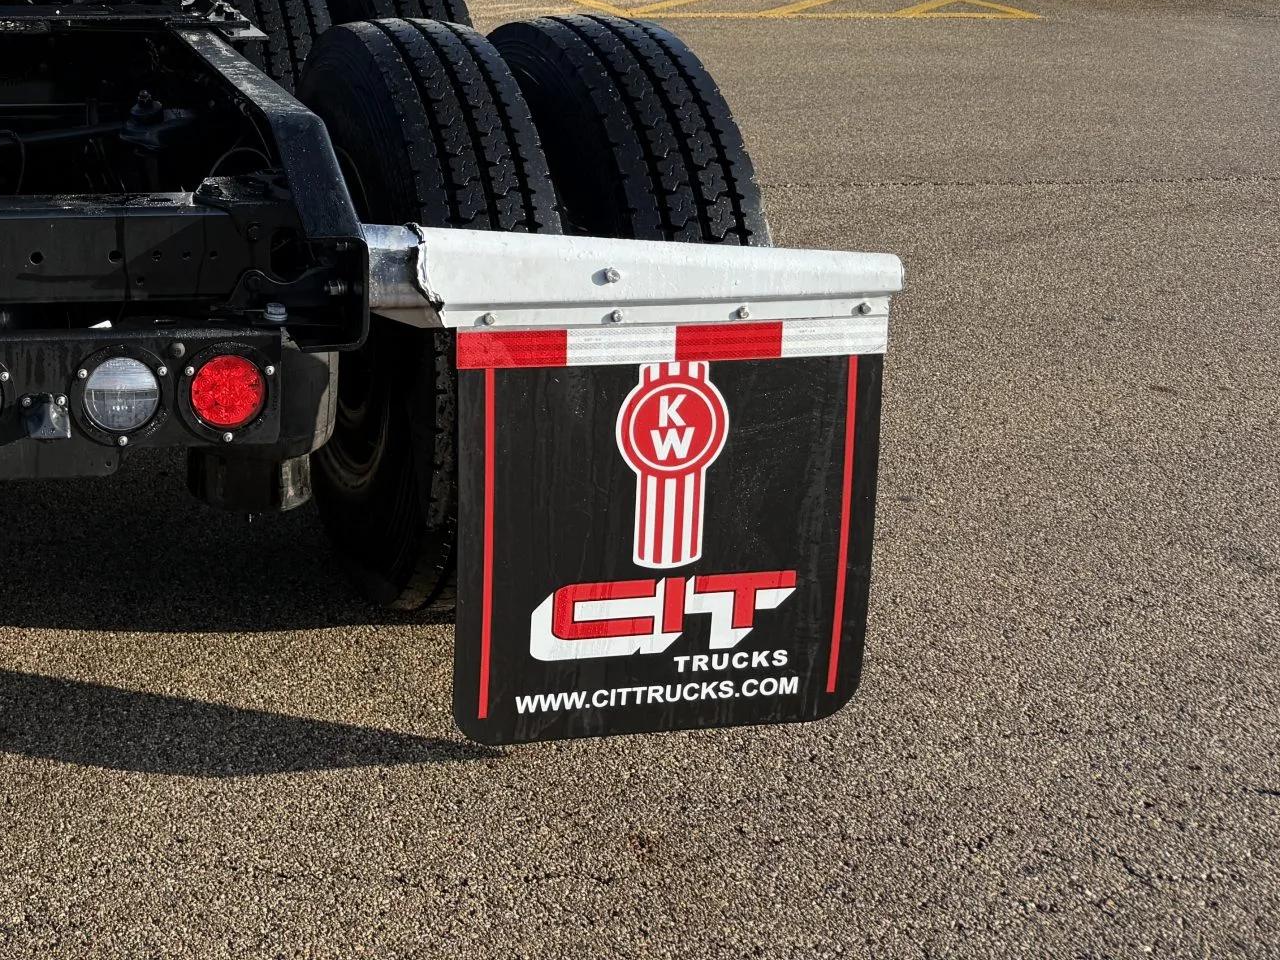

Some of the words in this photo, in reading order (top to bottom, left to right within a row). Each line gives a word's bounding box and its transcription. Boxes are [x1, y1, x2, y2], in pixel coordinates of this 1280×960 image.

[529, 570, 797, 661] CIT
[673, 649, 789, 674] TRUCKS
[515, 676, 799, 714] WWW.CITTRUCKS.COM
